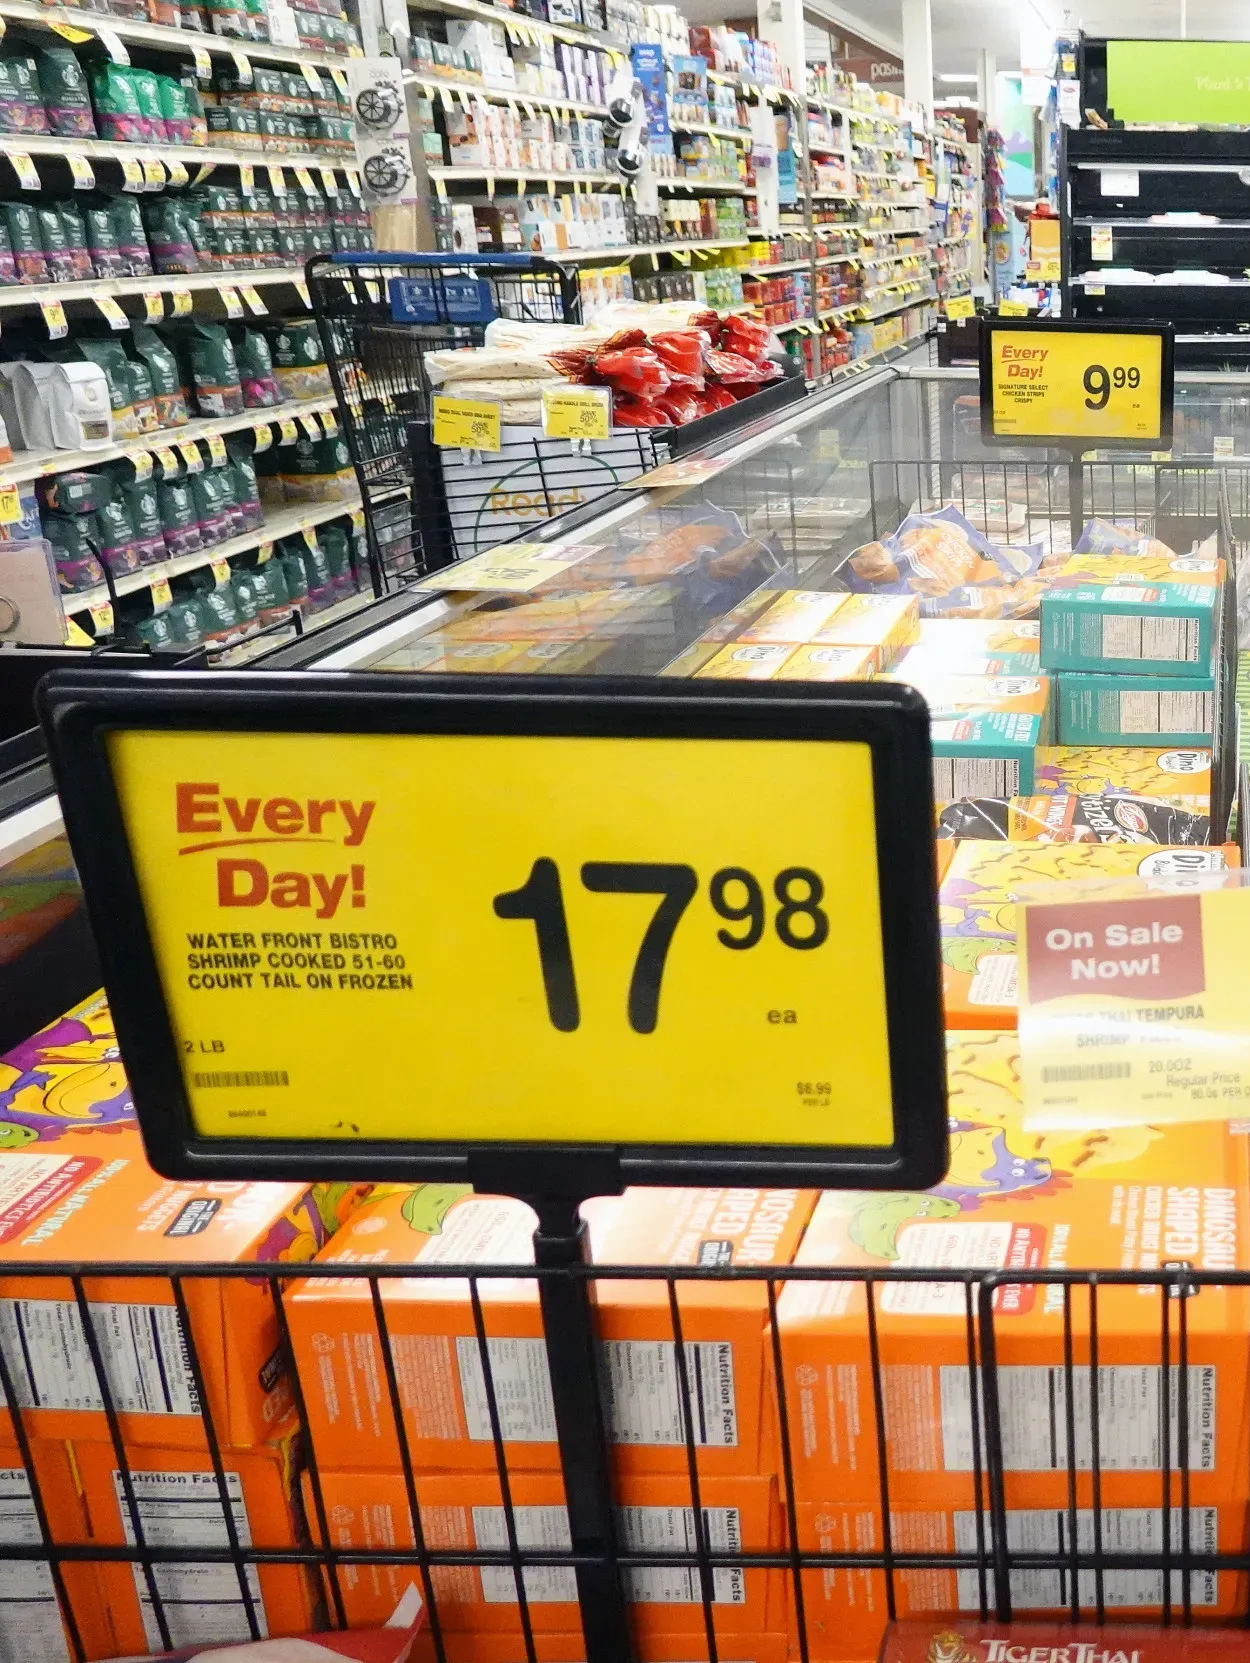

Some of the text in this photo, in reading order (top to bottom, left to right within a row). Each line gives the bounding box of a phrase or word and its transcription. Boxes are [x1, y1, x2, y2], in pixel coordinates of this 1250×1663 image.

[1002, 345, 1048, 361] Every
[1008, 364, 1043, 380] Day!
[1178, 752, 1197, 771] Dino
[176, 782, 377, 847] Every
[217, 858, 366, 919] Day!
[187, 933, 398, 950] WATER FRONT BISTRO
[1046, 921, 1184, 951] On Sale
[187, 953, 406, 970] SHRIMP COOKED 51-60
[1071, 955, 1161, 981] Now!
[188, 973, 413, 990] COUNT TAIL ON FROZEN
[767, 1008, 797, 1024] ea
[1136, 1005, 1204, 1022] TEMPURA
[184, 1040, 225, 1054] 2 LB
[1166, 1074, 1209, 1089] Regular
[1212, 1072, 1241, 1084] Price
[1164, 1187, 1199, 1256] SHAPED
[719, 1343, 734, 1444] Nutrition Facts
